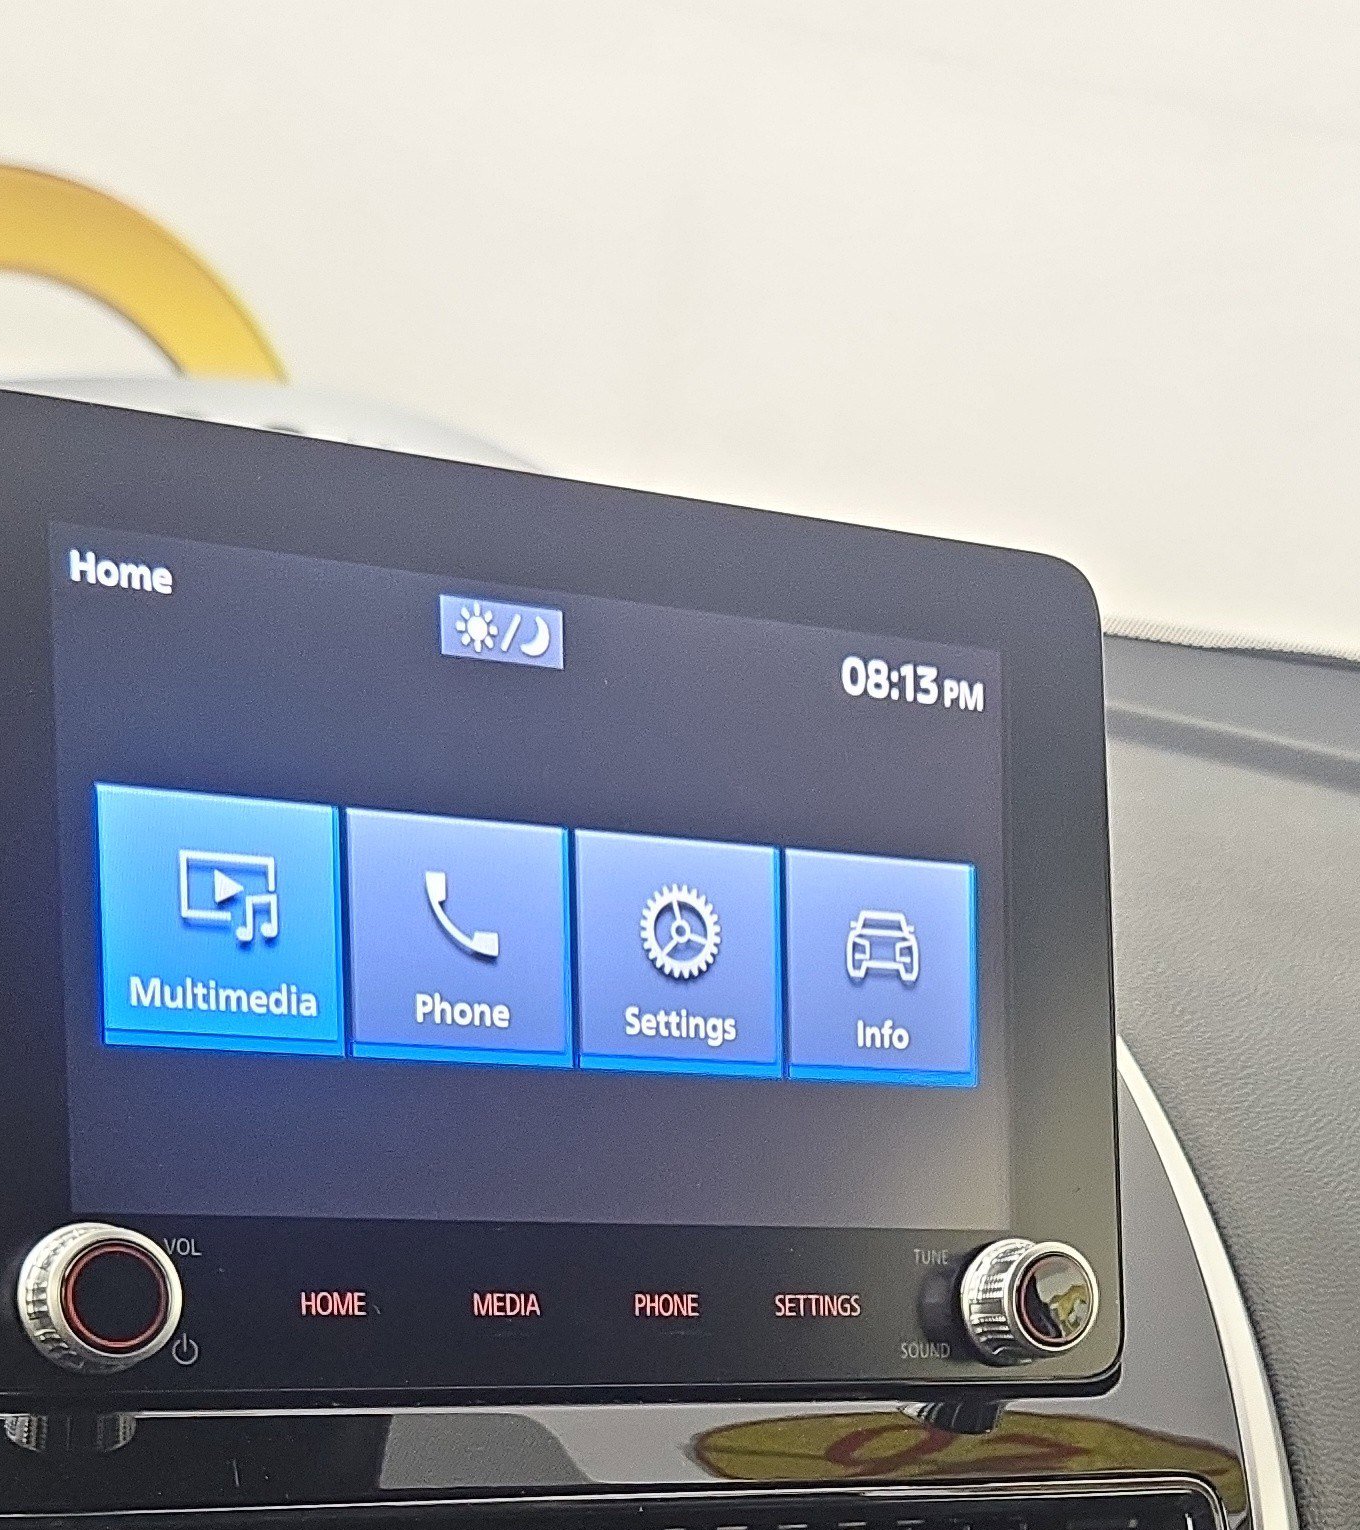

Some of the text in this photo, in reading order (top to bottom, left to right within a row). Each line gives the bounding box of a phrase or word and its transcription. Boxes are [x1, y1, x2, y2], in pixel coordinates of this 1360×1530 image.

[69, 550, 173, 595] Home
[841, 656, 985, 713] 08:13 PM
[129, 978, 319, 1018] Multimedia
[415, 992, 511, 1030] Phone
[624, 1004, 738, 1046] Settings
[856, 1018, 911, 1052] Info
[164, 1238, 202, 1257] VOL
[914, 1248, 949, 1266] TUNE
[301, 1292, 367, 1317] HOME
[472, 1292, 541, 1317] MEDIA
[634, 1293, 700, 1318] PHONE
[774, 1294, 862, 1318] SETTINGS
[900, 1342, 951, 1360] SOUND
